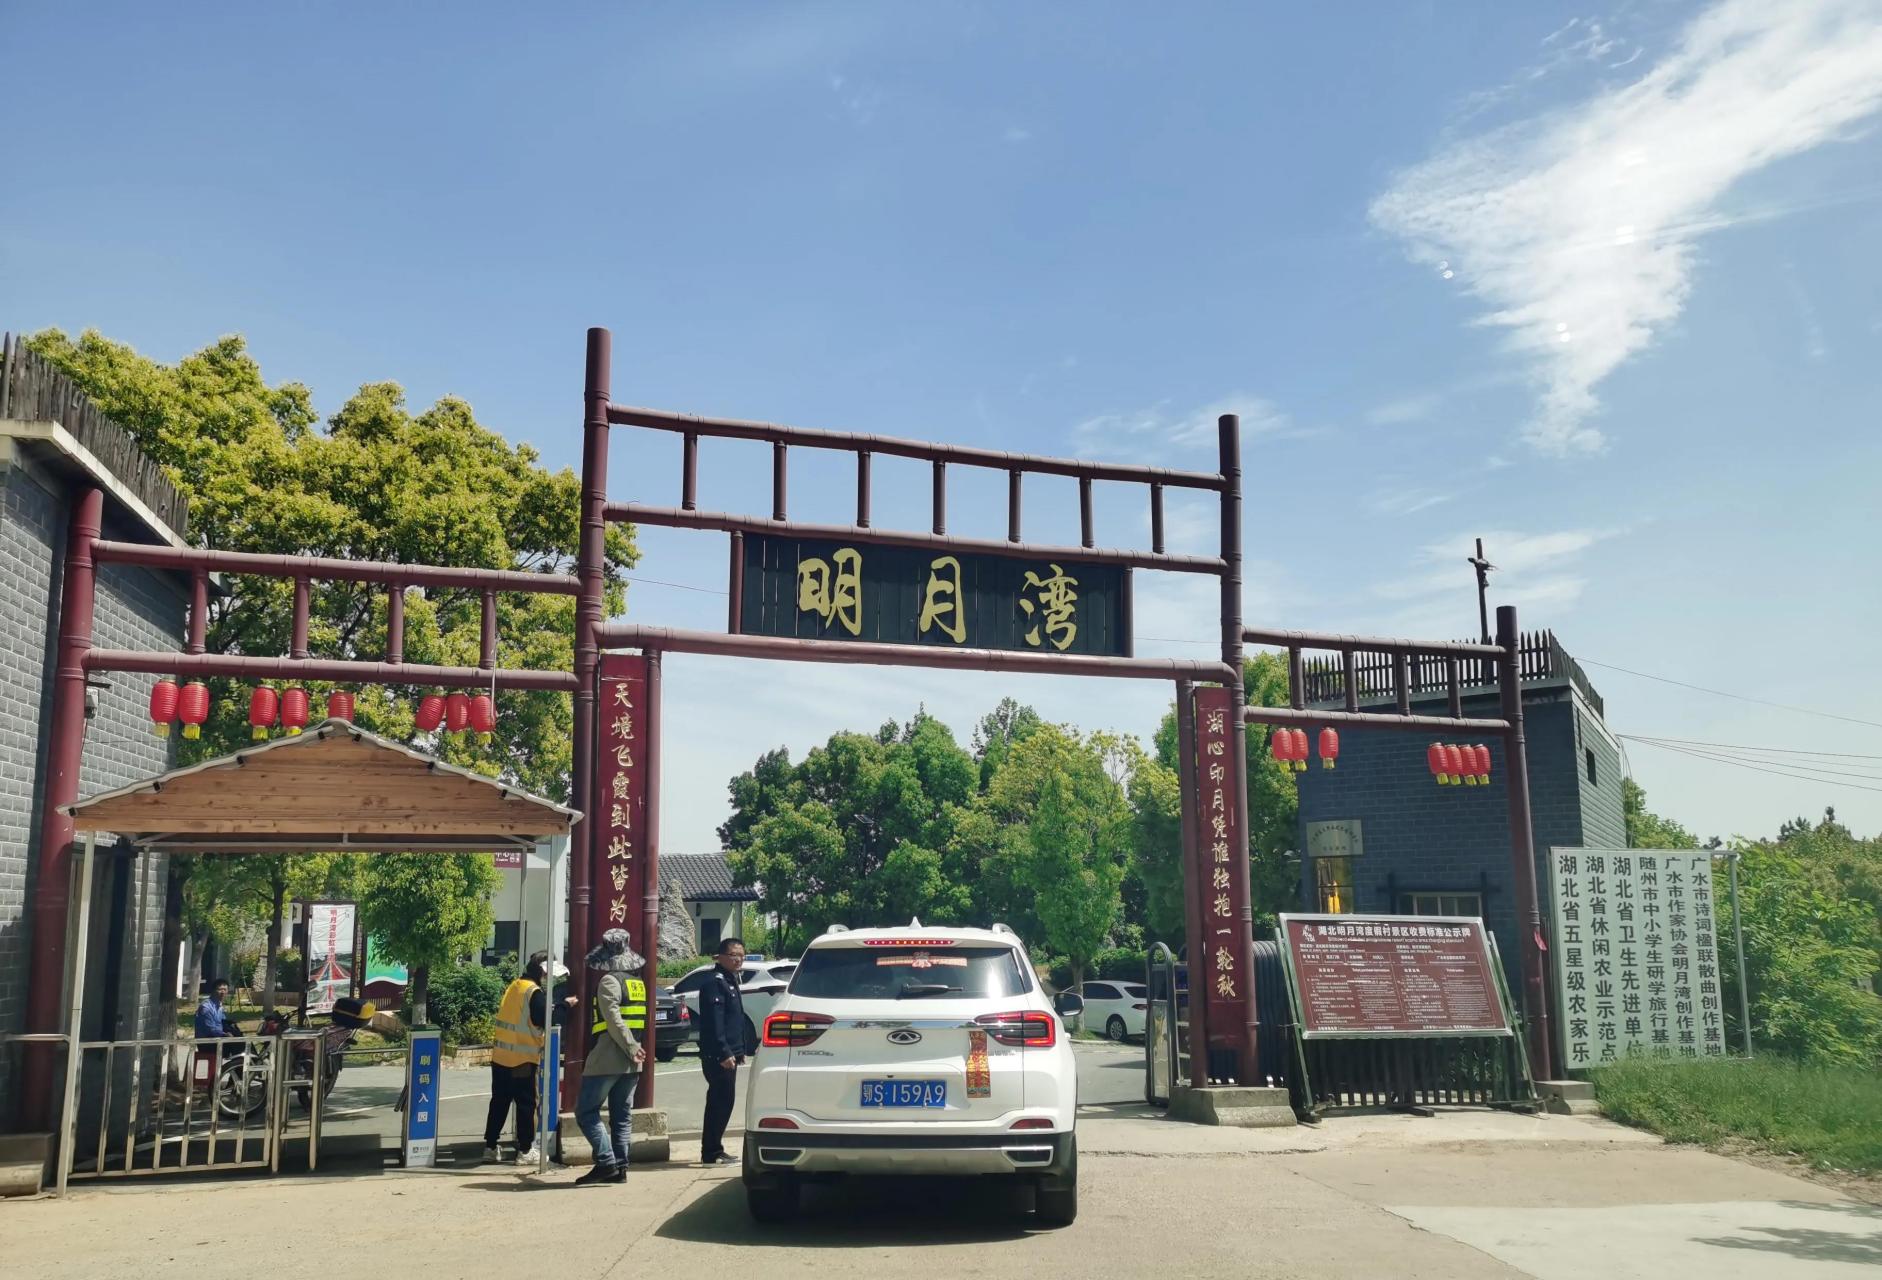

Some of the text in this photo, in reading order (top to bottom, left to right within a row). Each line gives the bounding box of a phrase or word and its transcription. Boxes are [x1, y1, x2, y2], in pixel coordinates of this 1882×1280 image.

[798, 547, 1078, 651] 明月湾
[1559, 855, 1590, 1063] 湖北省五星级农家乐
[1586, 855, 1617, 1062] 湖北省休闲农业示范点
[1639, 856, 1670, 1059] 随州市中小学生研学旅行基地
[1665, 857, 1696, 1059] 广水市作家协会明月湾创作基地
[1691, 857, 1722, 1058] 广水市诗词楹联散曲创作基地
